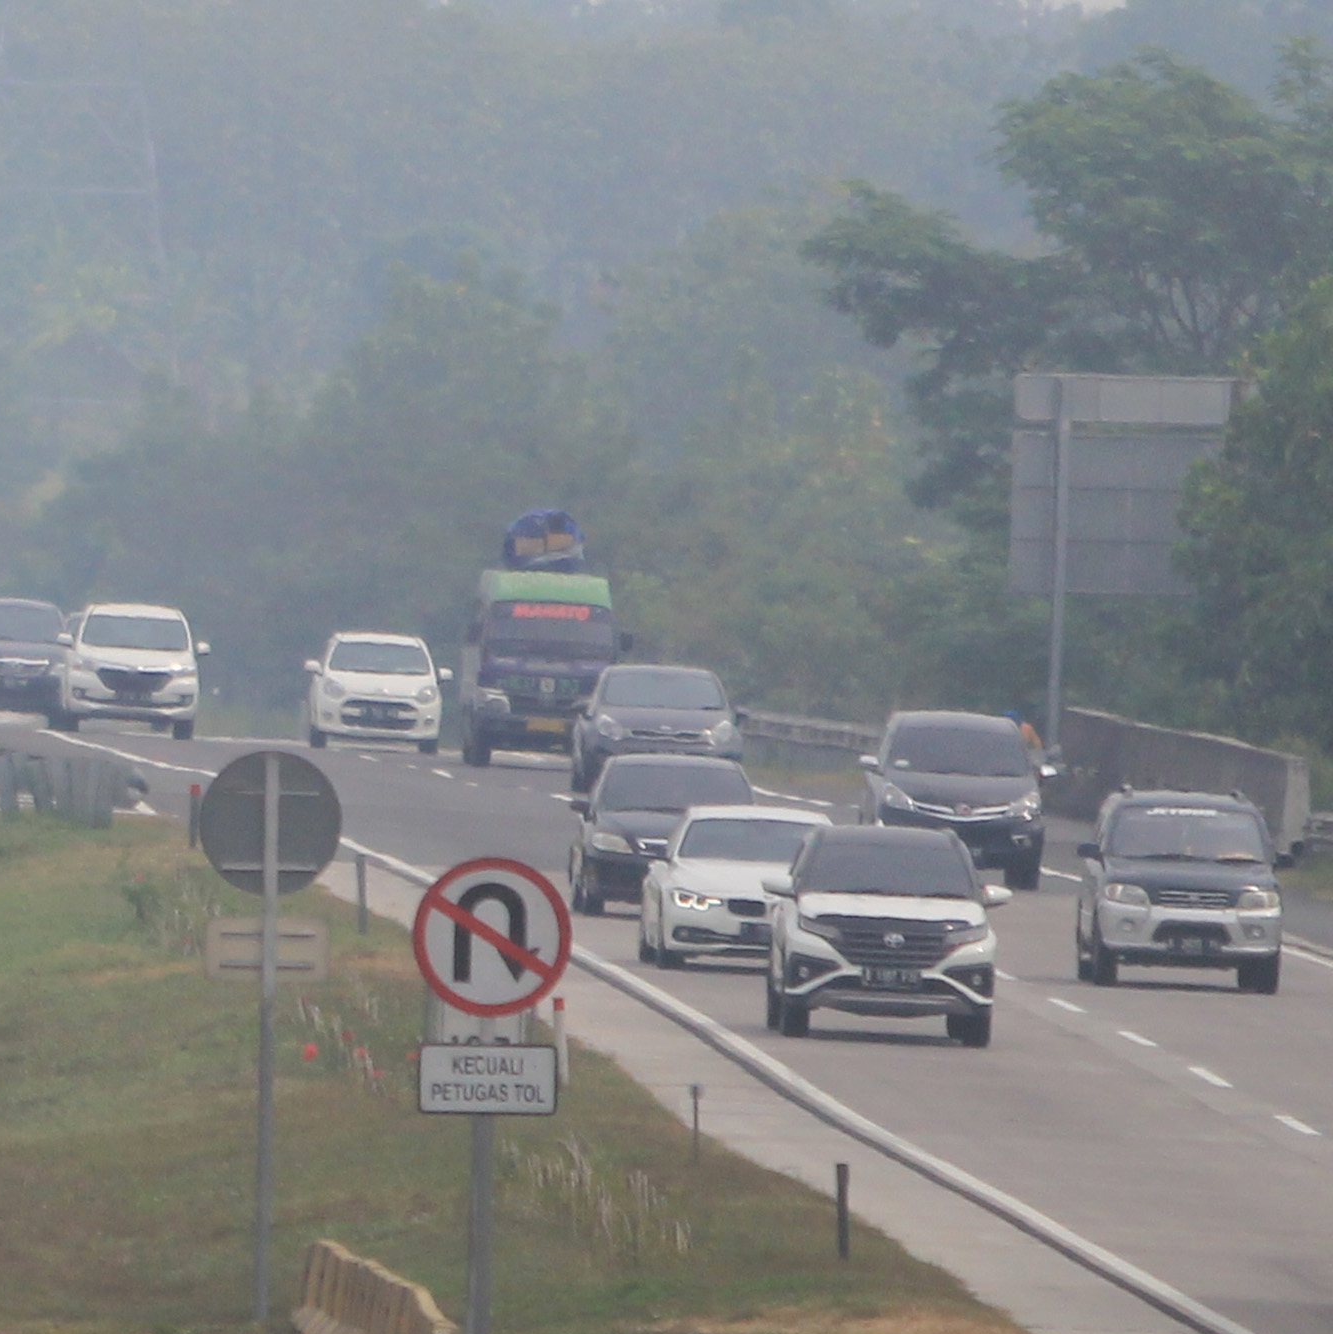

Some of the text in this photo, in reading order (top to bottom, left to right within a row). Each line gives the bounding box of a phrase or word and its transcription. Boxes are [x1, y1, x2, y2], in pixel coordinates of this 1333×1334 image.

[452, 1055, 524, 1076] KECUALI
[431, 1082, 545, 1103] PETUGAS TOL
